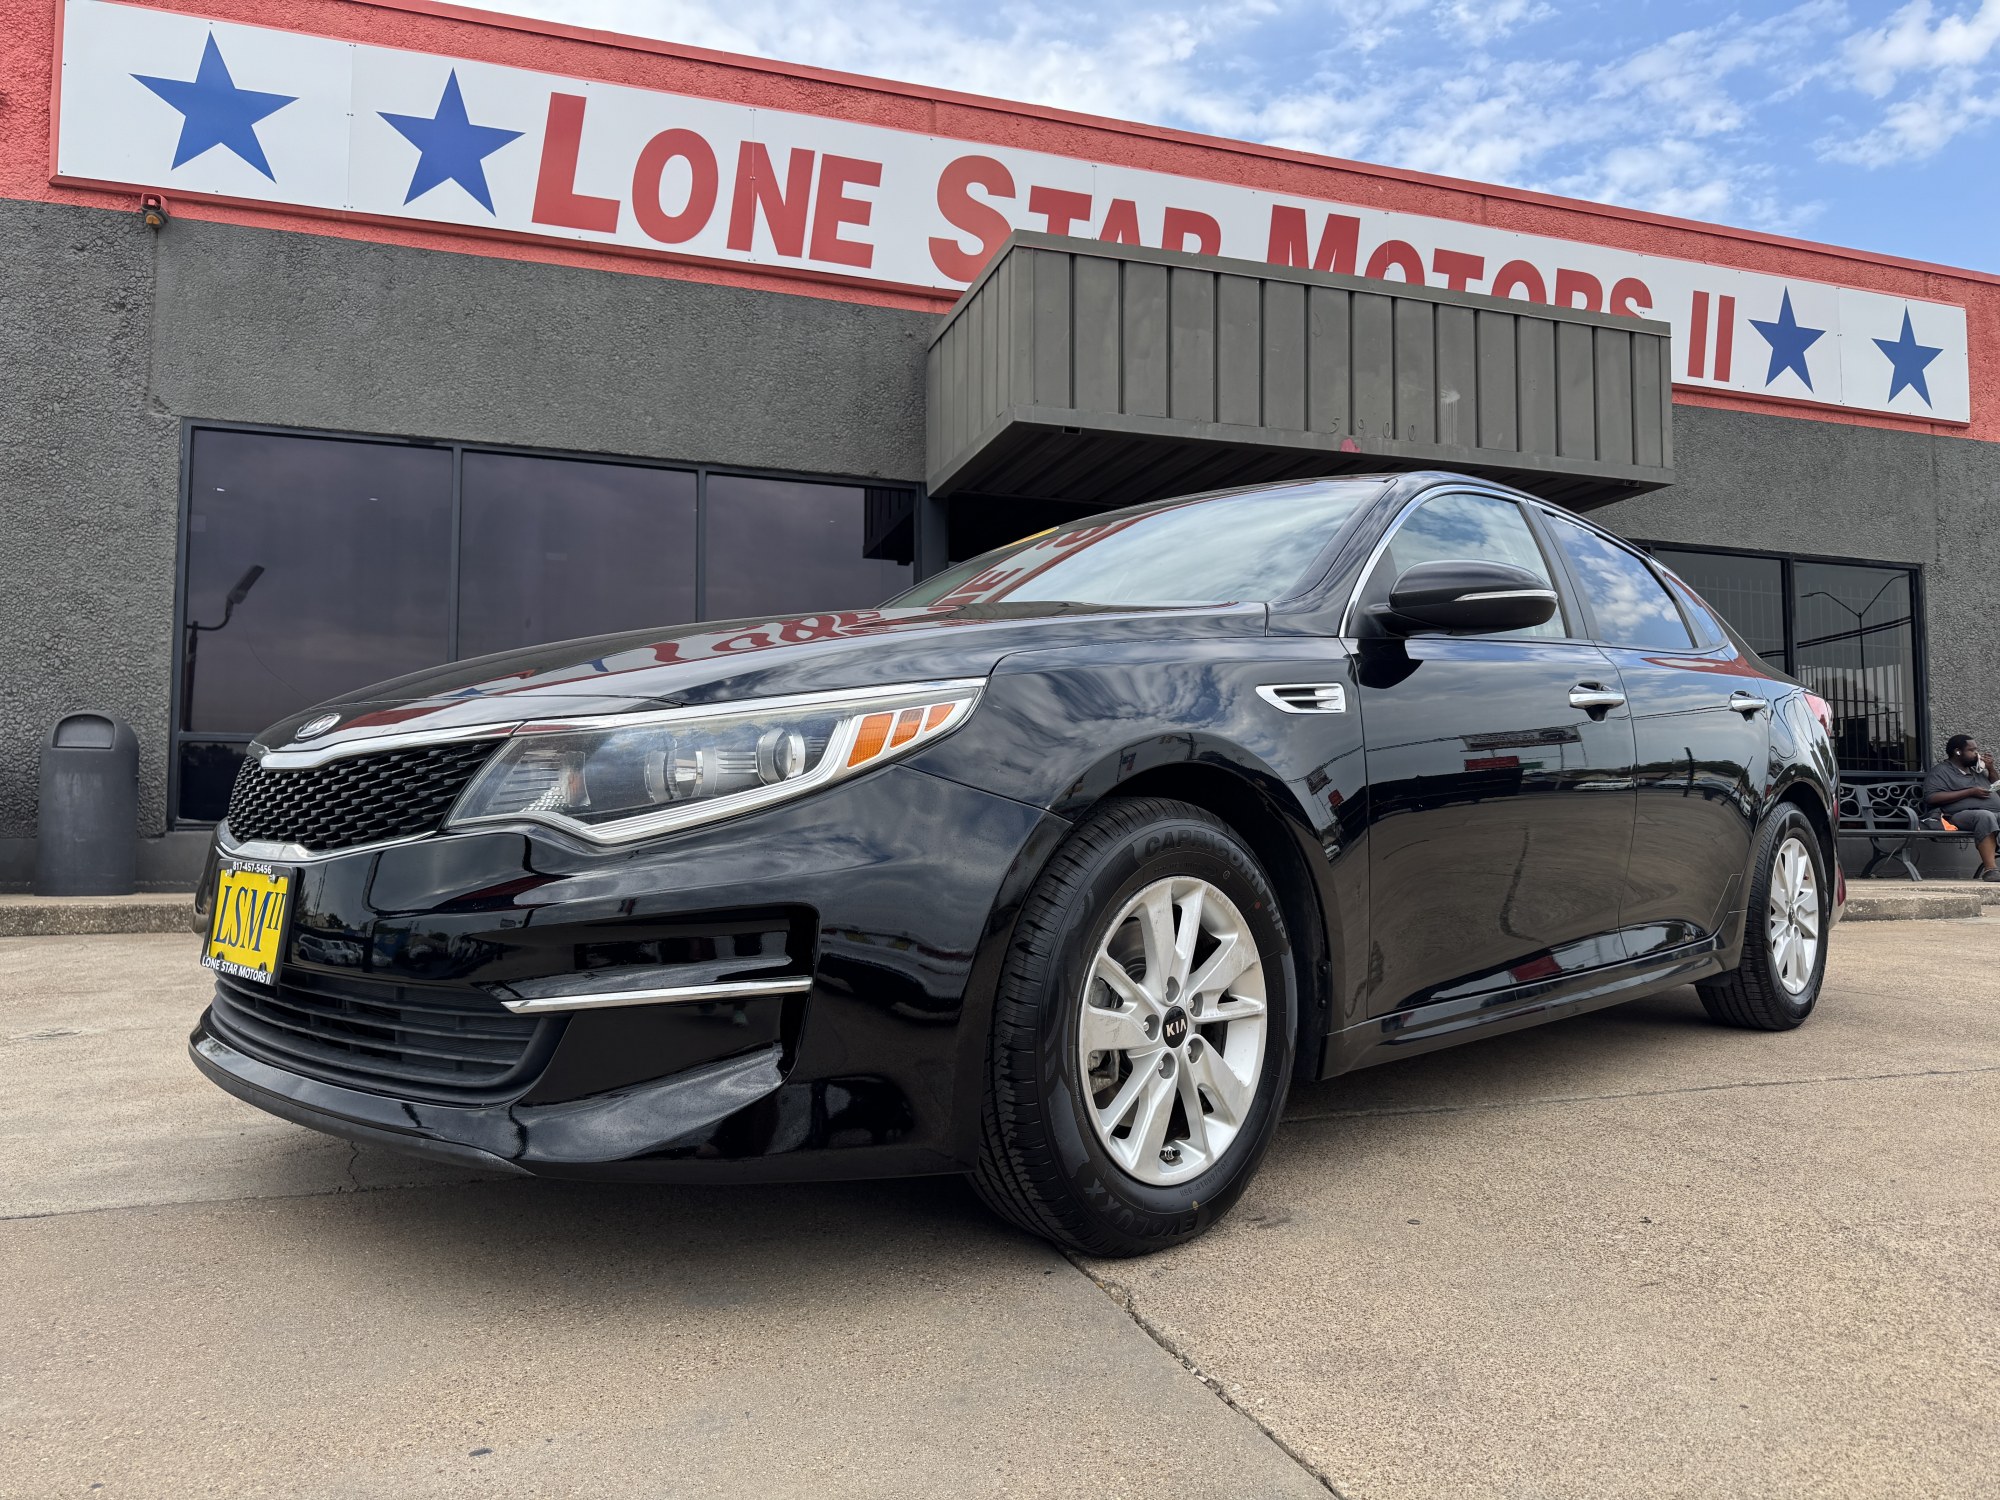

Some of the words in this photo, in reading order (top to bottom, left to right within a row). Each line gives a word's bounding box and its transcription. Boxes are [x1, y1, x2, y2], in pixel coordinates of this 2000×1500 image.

[531, 92, 883, 269] LONE
[1687, 290, 1736, 383] II
[232, 861, 272, 875] 817-457-5456
[1144, 829, 1267, 895] CAPRICORN
[1266, 901, 1286, 939] HP
[214, 885, 272, 952] LSM
[201, 955, 220, 970] LONE
[220, 961, 238, 975] STAR
[239, 965, 267, 983] MOTORS
[1165, 1018, 1187, 1038] KIA
